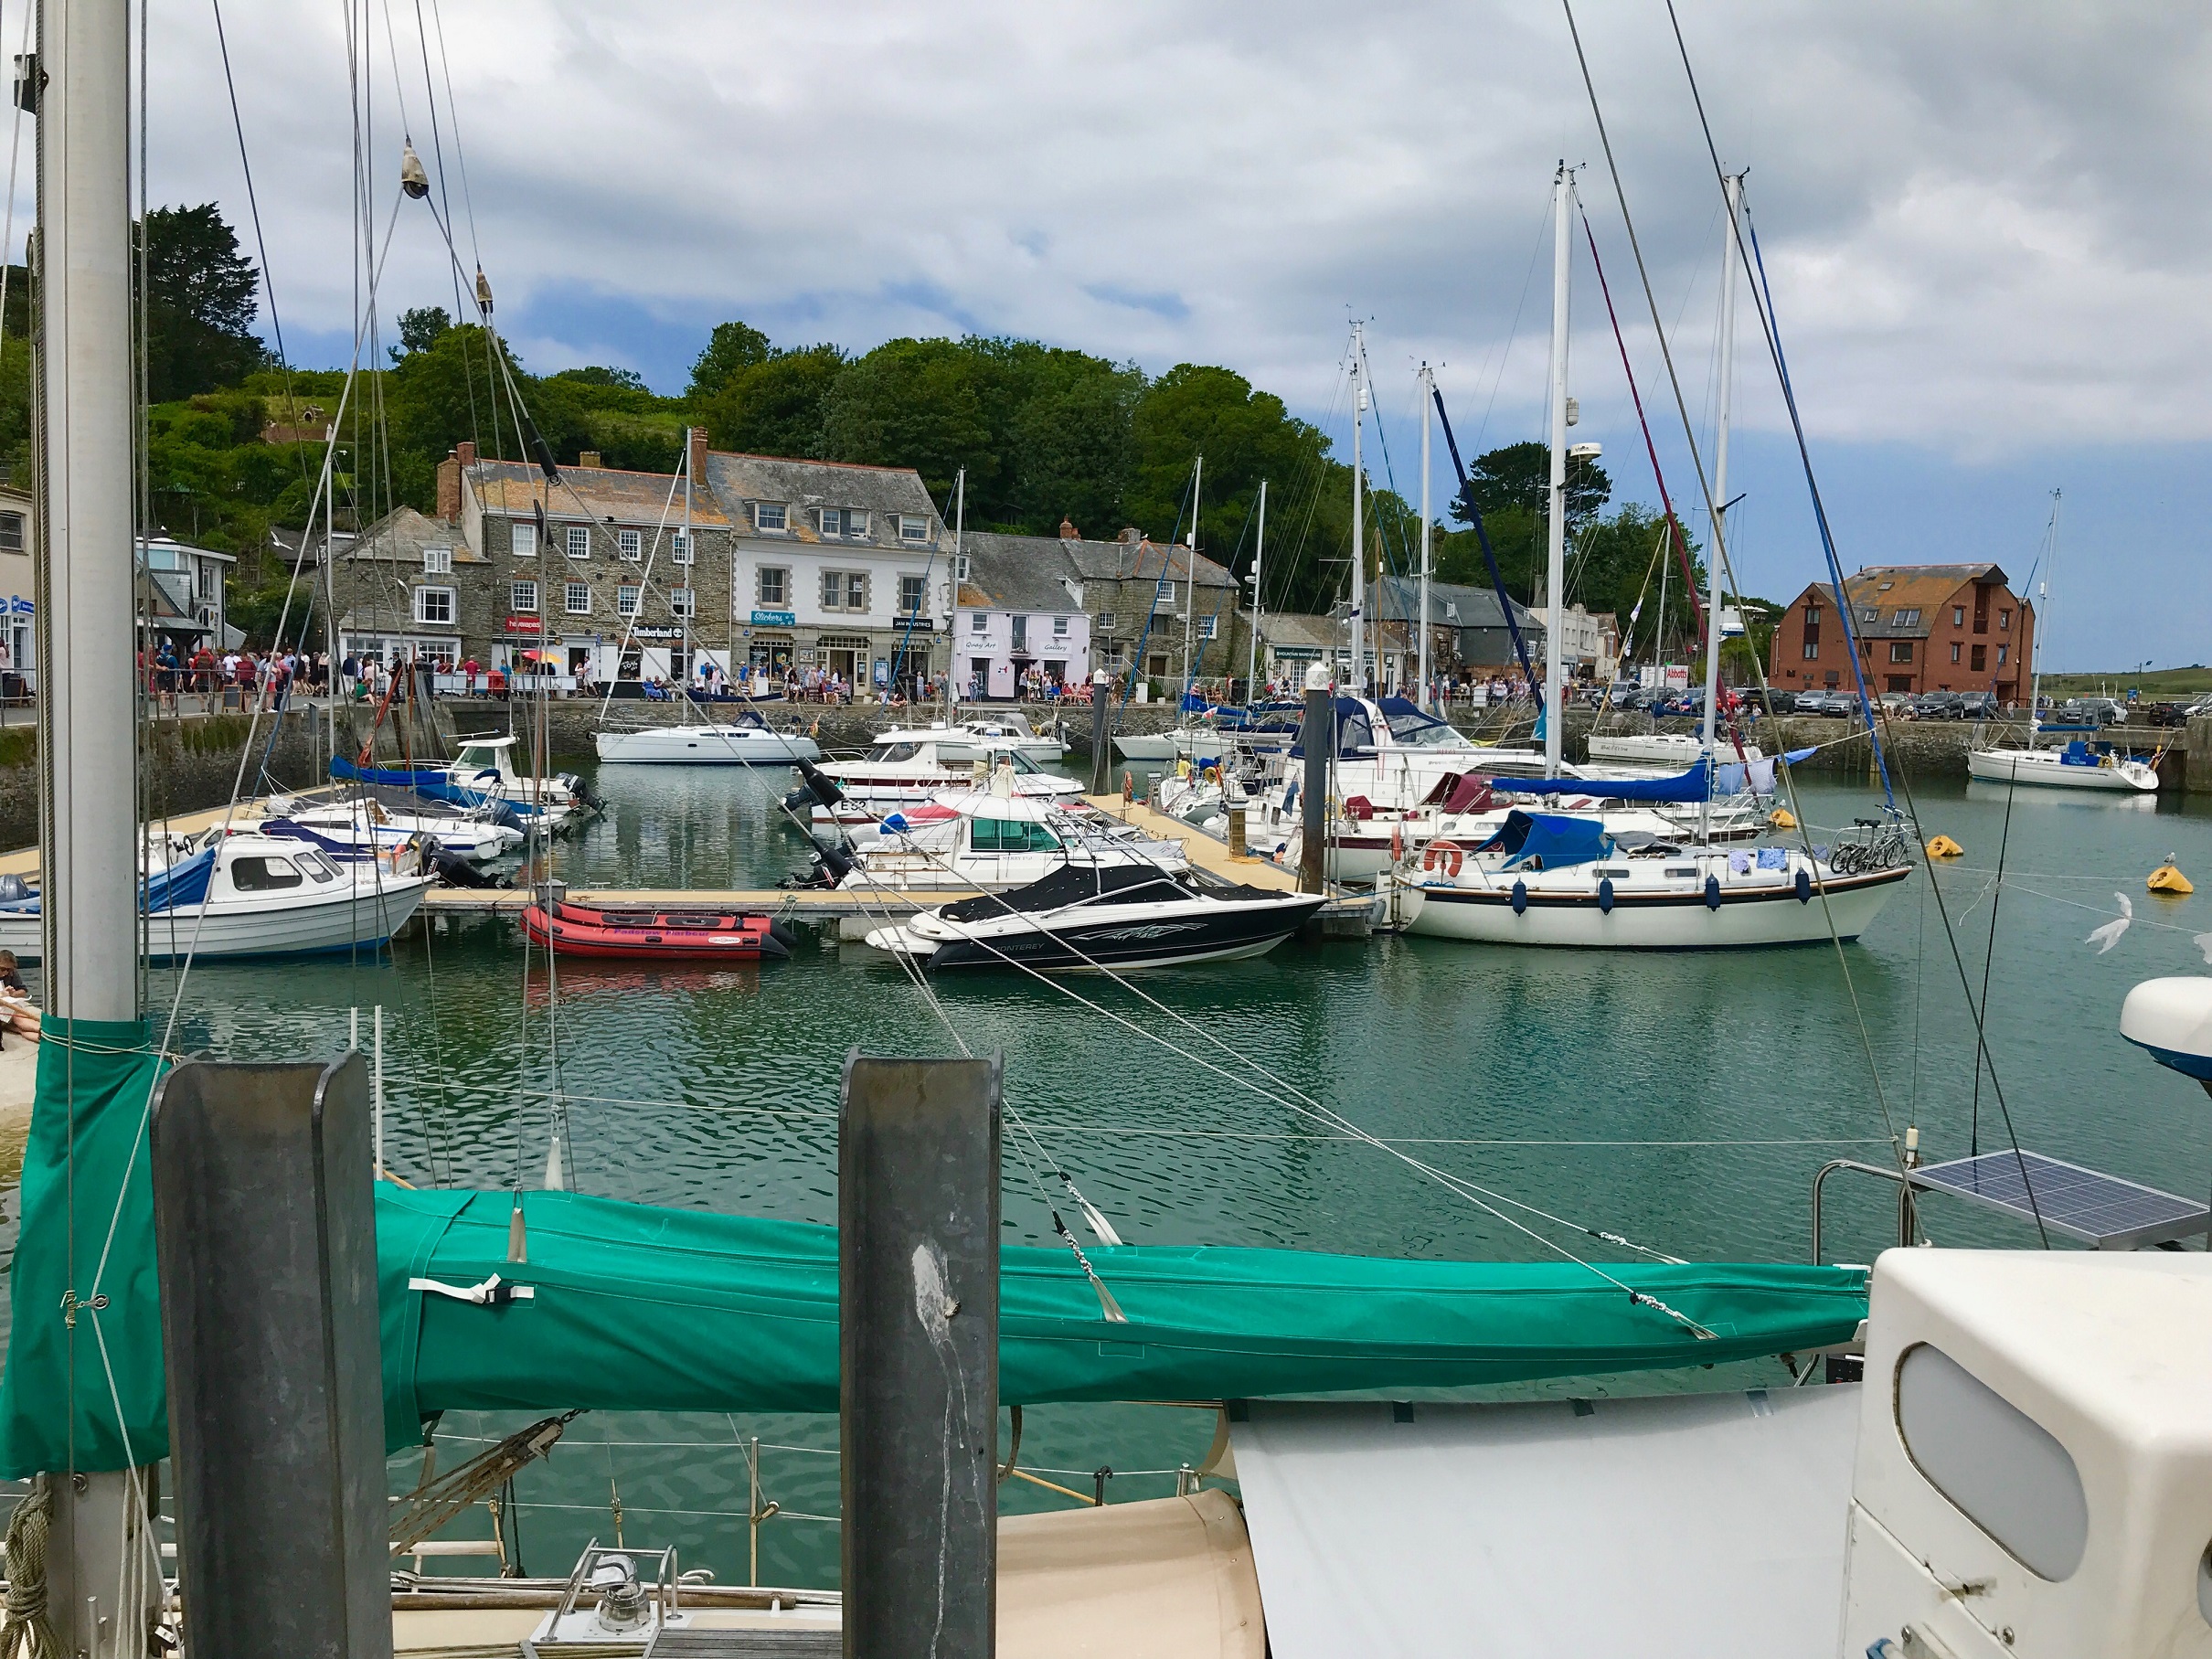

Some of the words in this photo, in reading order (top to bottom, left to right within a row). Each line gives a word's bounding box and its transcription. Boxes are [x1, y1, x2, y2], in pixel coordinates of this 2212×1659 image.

[754, 612, 783, 622] Slickers
[633, 627, 673, 638] Timberland
[1667, 668, 1687, 678] Abbotts
